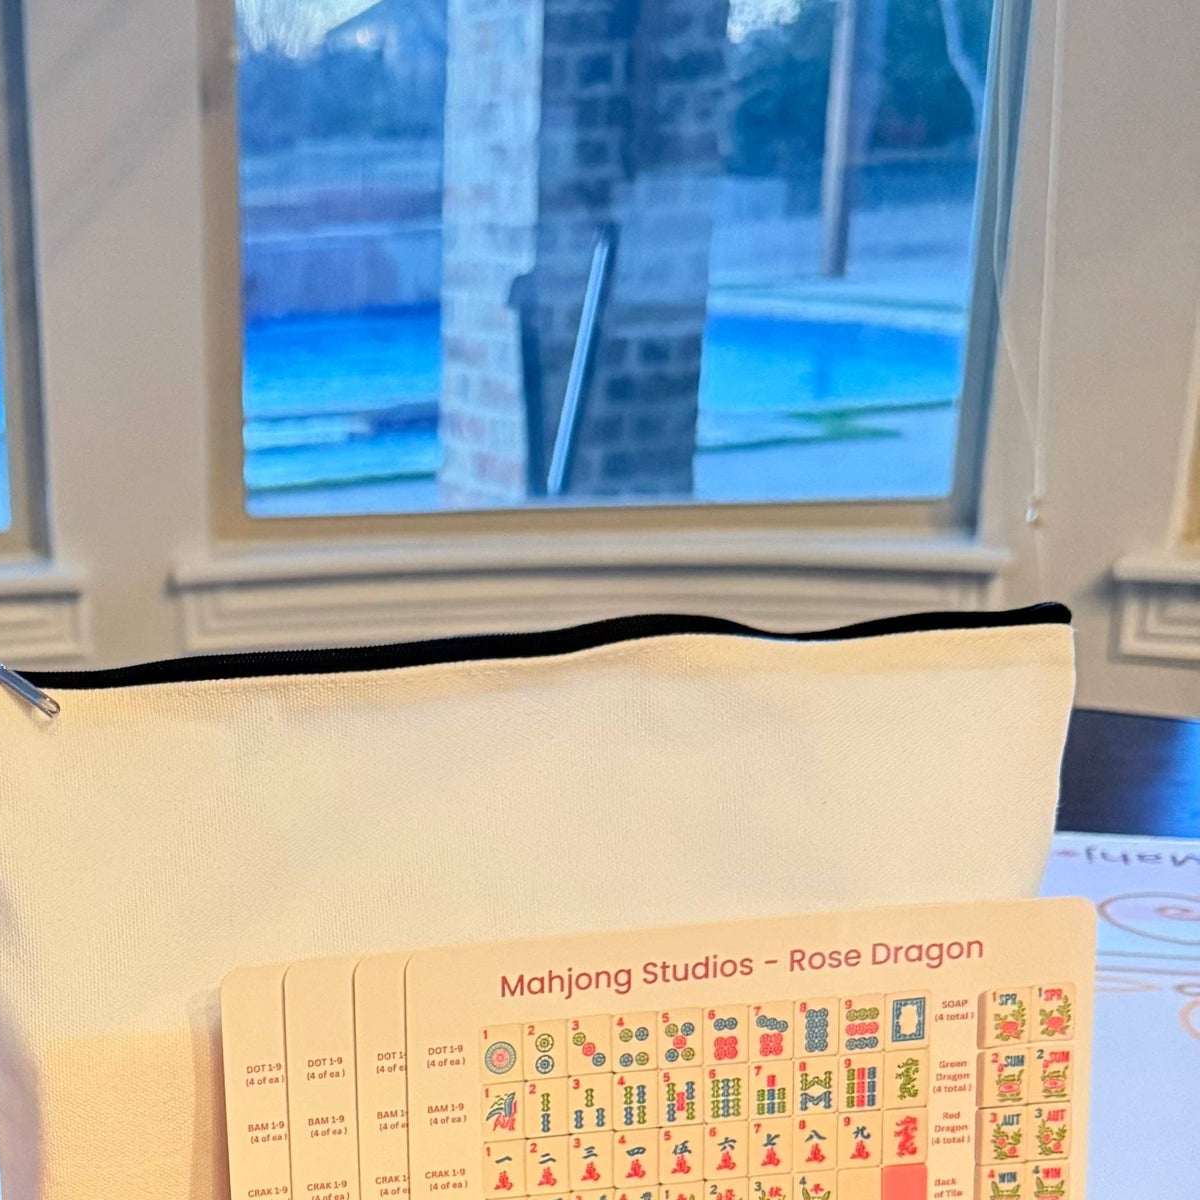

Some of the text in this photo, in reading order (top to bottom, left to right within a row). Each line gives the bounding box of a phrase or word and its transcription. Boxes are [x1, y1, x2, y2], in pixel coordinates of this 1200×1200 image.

[501, 938, 984, 999] Mahjong Studios Rose Dragon
[999, 988, 1063, 1006] SPR SPR
[942, 999, 969, 1009] SOAP
[947, 1011, 969, 1021] total
[428, 1044, 464, 1056] DOT 1-9
[377, 1052, 397, 1061] DOT
[1004, 1051, 1070, 1068] SUM SUM
[307, 1057, 343, 1068] DOT 1-9
[438, 1058, 448, 1067] of
[939, 1060, 968, 1069] Green
[246, 1063, 282, 1074] DOT 1-9
[318, 1070, 327, 1079] of
[936, 1072, 970, 1082] Dragon
[257, 1076, 267, 1085] of
[944, 1083, 967, 1092] total
[427, 1102, 465, 1114] BAM 1-9
[377, 1110, 398, 1119] BAM
[440, 1115, 449, 1124] of
[943, 1111, 961, 1120] Red
[1001, 1108, 1066, 1126] AUT AUT
[308, 1115, 345, 1126] BAM 1-9
[248, 1121, 285, 1132] BAM 1-9
[934, 1124, 968, 1134] Dragon
[321, 1128, 331, 1137] of
[261, 1134, 270, 1143] of
[943, 1136, 966, 1145] total
[425, 1168, 466, 1179] CRAK 1-9
[998, 1167, 1061, 1183] WIN WIN
[375, 1175, 400, 1185] CRAK
[934, 1178, 957, 1187] Back
[306, 1180, 348, 1192] CRAK 1-9
[440, 1181, 450, 1190] of
[248, 1186, 288, 1198] CRAK 1-9
[934, 1189, 963, 1199] of Tile
